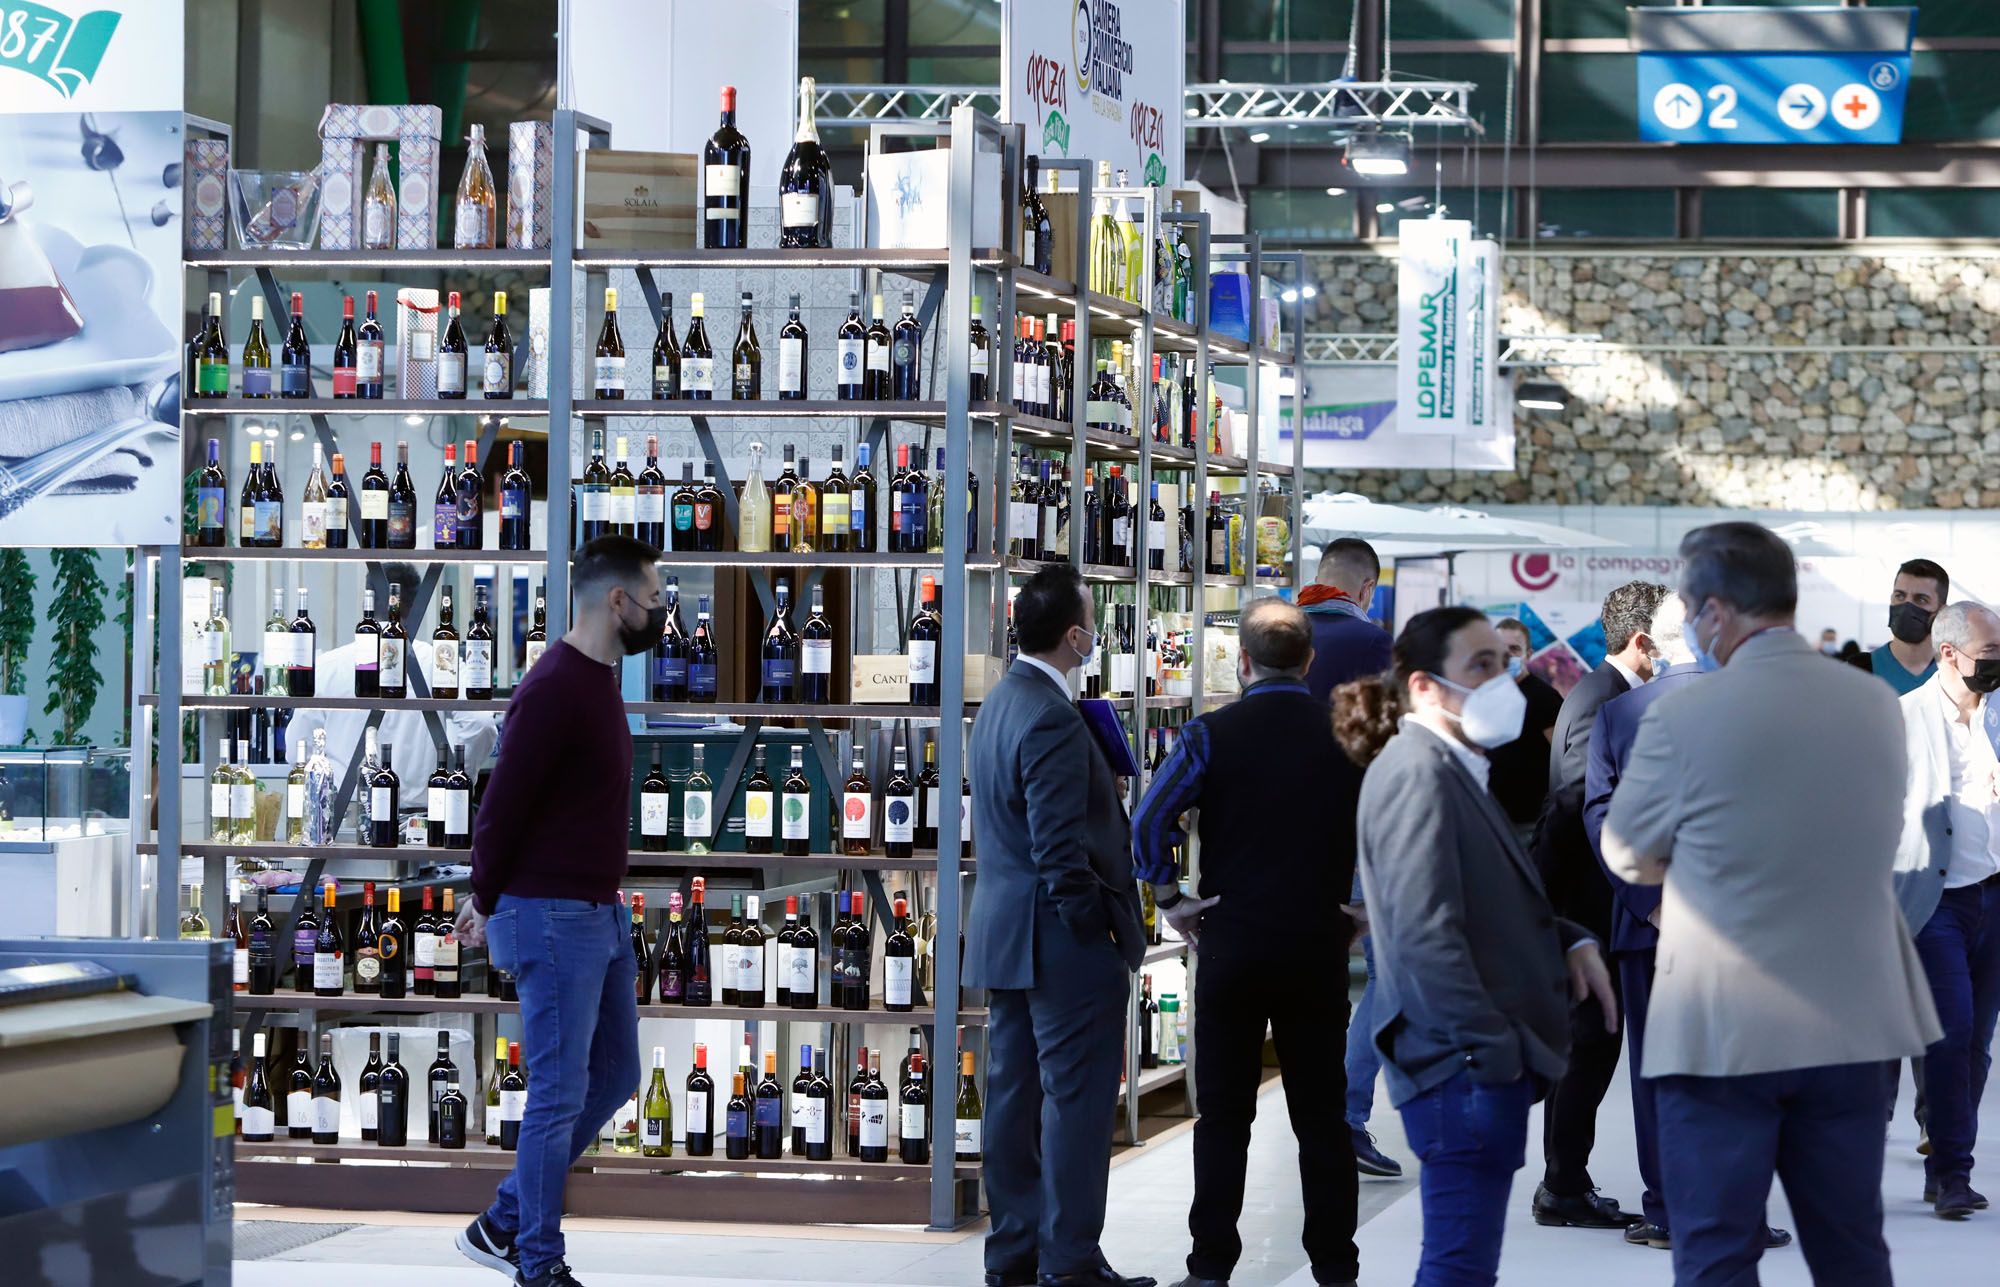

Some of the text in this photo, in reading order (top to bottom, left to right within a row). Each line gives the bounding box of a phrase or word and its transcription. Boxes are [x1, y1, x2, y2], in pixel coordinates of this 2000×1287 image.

[1092, 0, 1121, 38] CAMERA
[1092, 27, 1133, 75] COMMERCIO
[1092, 59, 1122, 101] ITALIANA
[1707, 84, 1738, 129] 2
[1417, 291, 1438, 418] LOPEMAR
[1586, 556, 1689, 575] compagn
